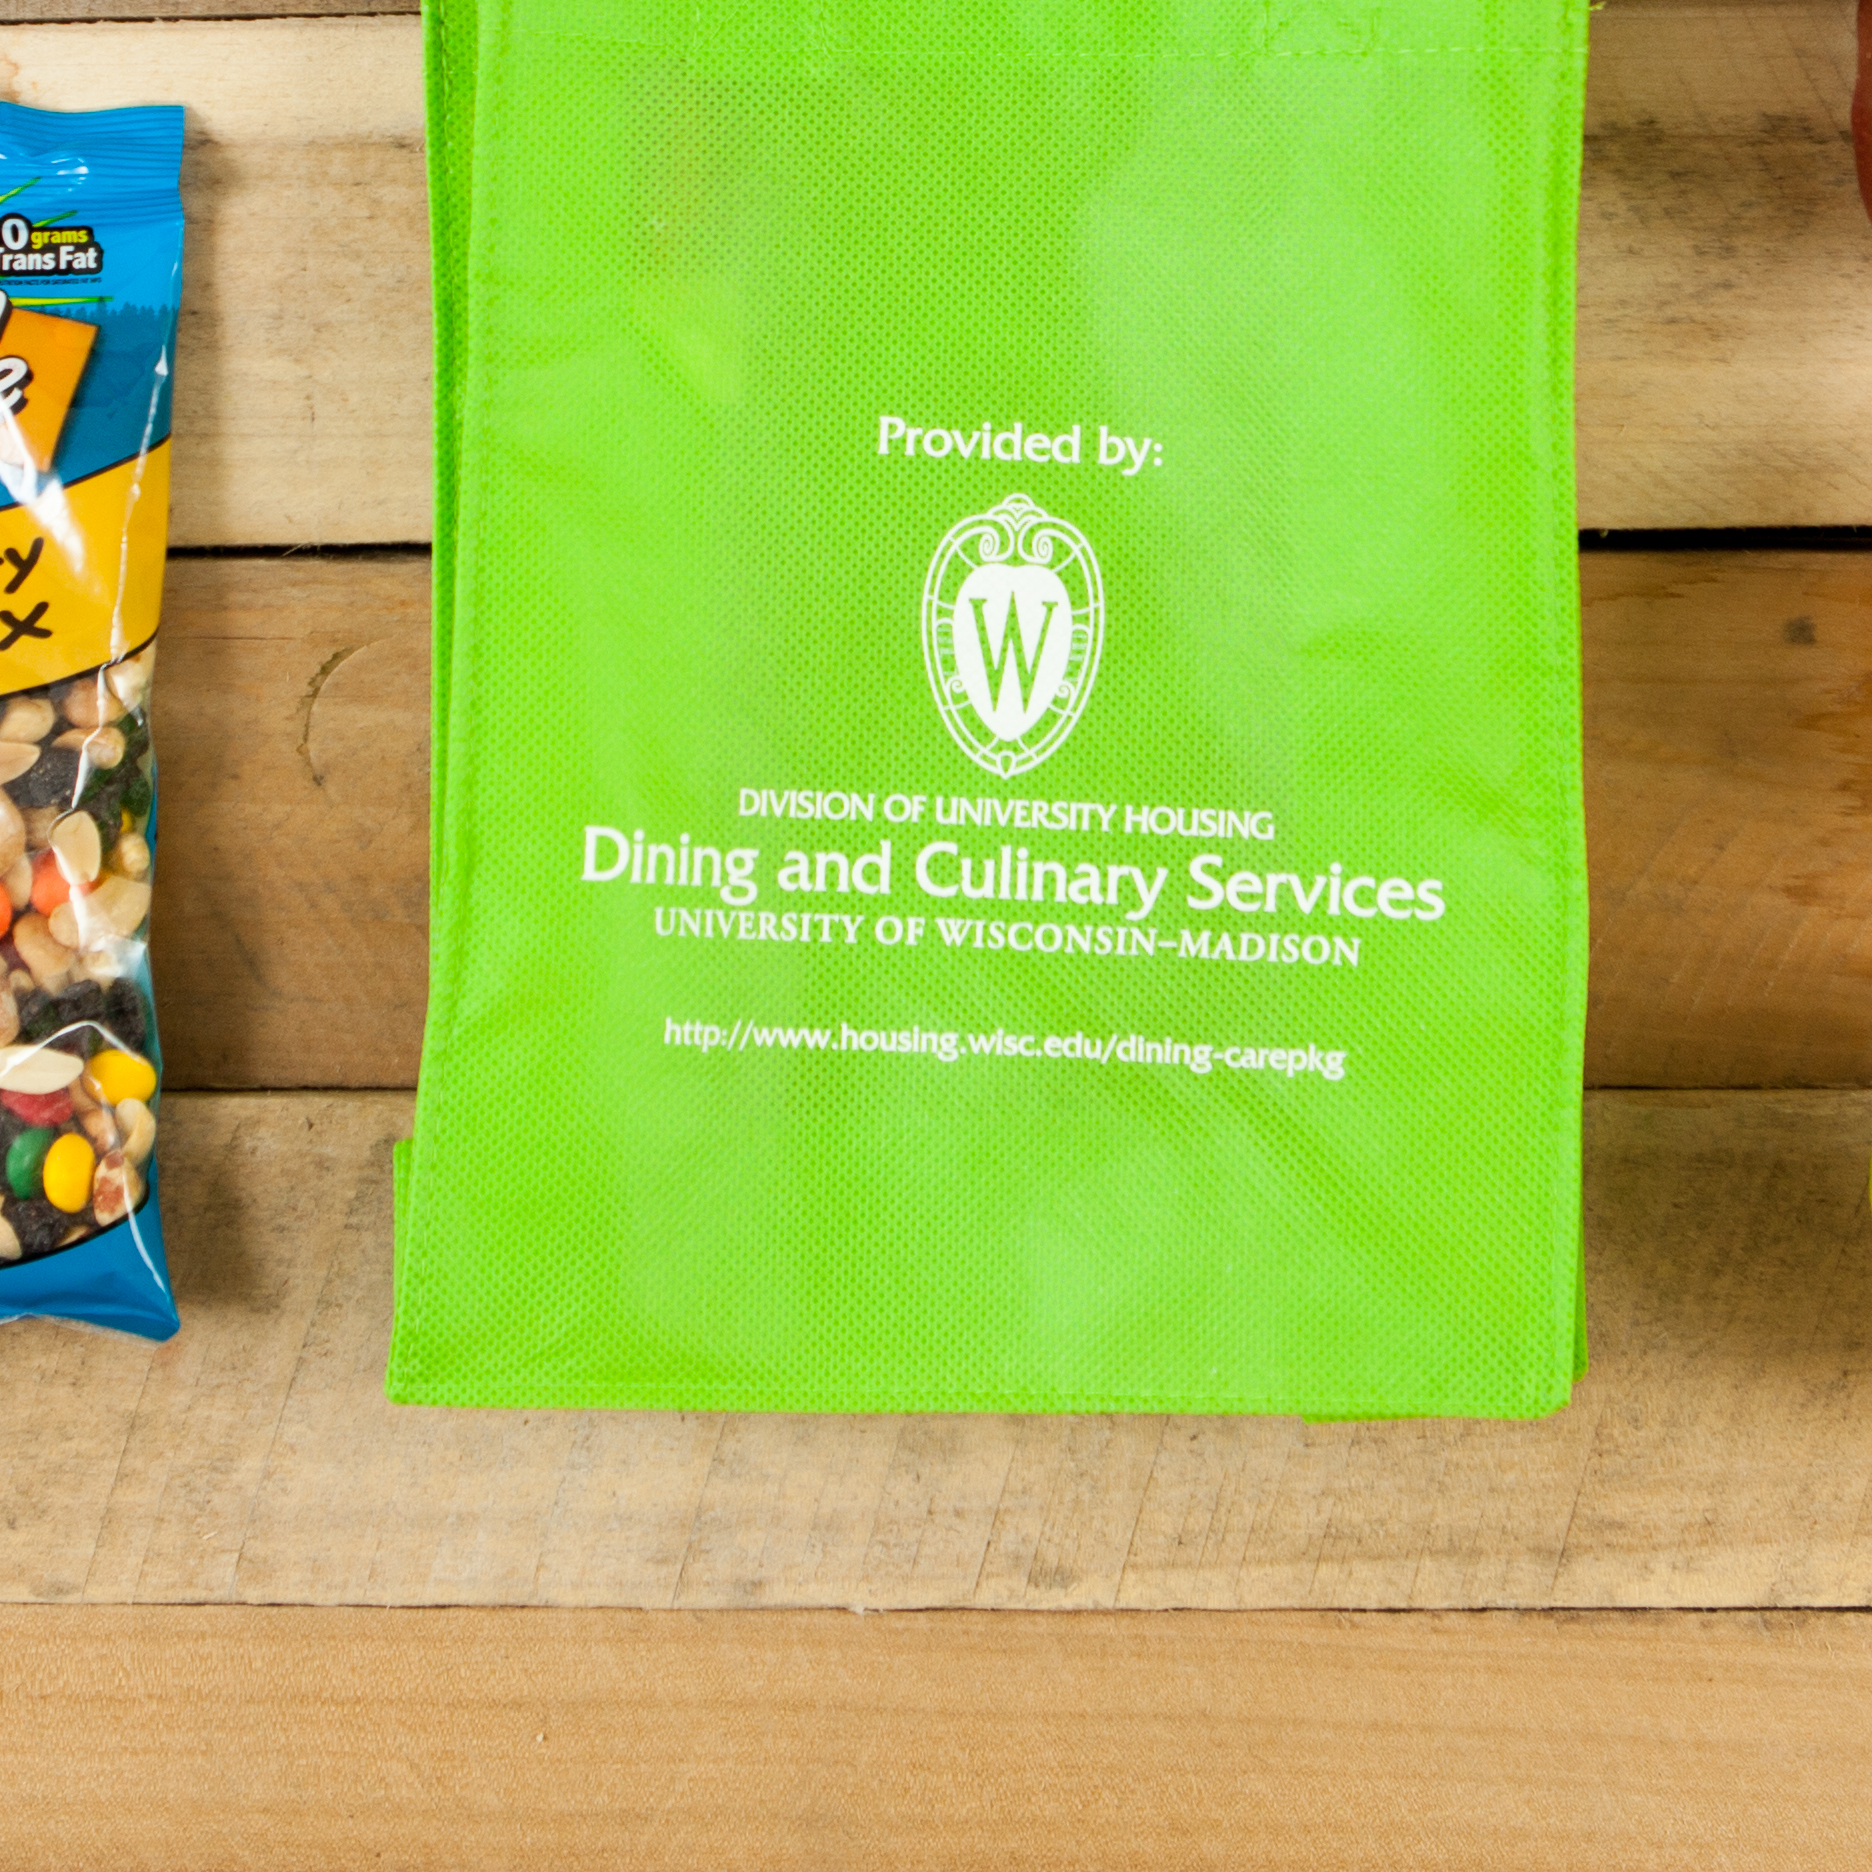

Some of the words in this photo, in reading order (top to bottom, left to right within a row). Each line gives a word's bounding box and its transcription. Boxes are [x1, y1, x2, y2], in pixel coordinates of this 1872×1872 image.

[1, 218, 29, 250] 0
[30, 230, 89, 249] grams
[59, 245, 98, 269] Fat
[878, 415, 1081, 463] Provided
[1098, 424, 1163, 476] by:
[968, 590, 1059, 715] W
[738, 788, 875, 821] DIVISION
[883, 793, 927, 822] OF
[935, 796, 1117, 832] UNIVERSITY
[1124, 805, 1276, 840] HOUSING
[581, 825, 760, 906] Dining
[777, 839, 892, 894] and
[915, 840, 1169, 921] Culinary
[1186, 853, 1446, 921] Services
[654, 906, 864, 943] UNIVERSITY
[874, 915, 926, 946] OF
[663, 1016, 1347, 1081] http://www.housing.wisc.edu/dining-carepkg
